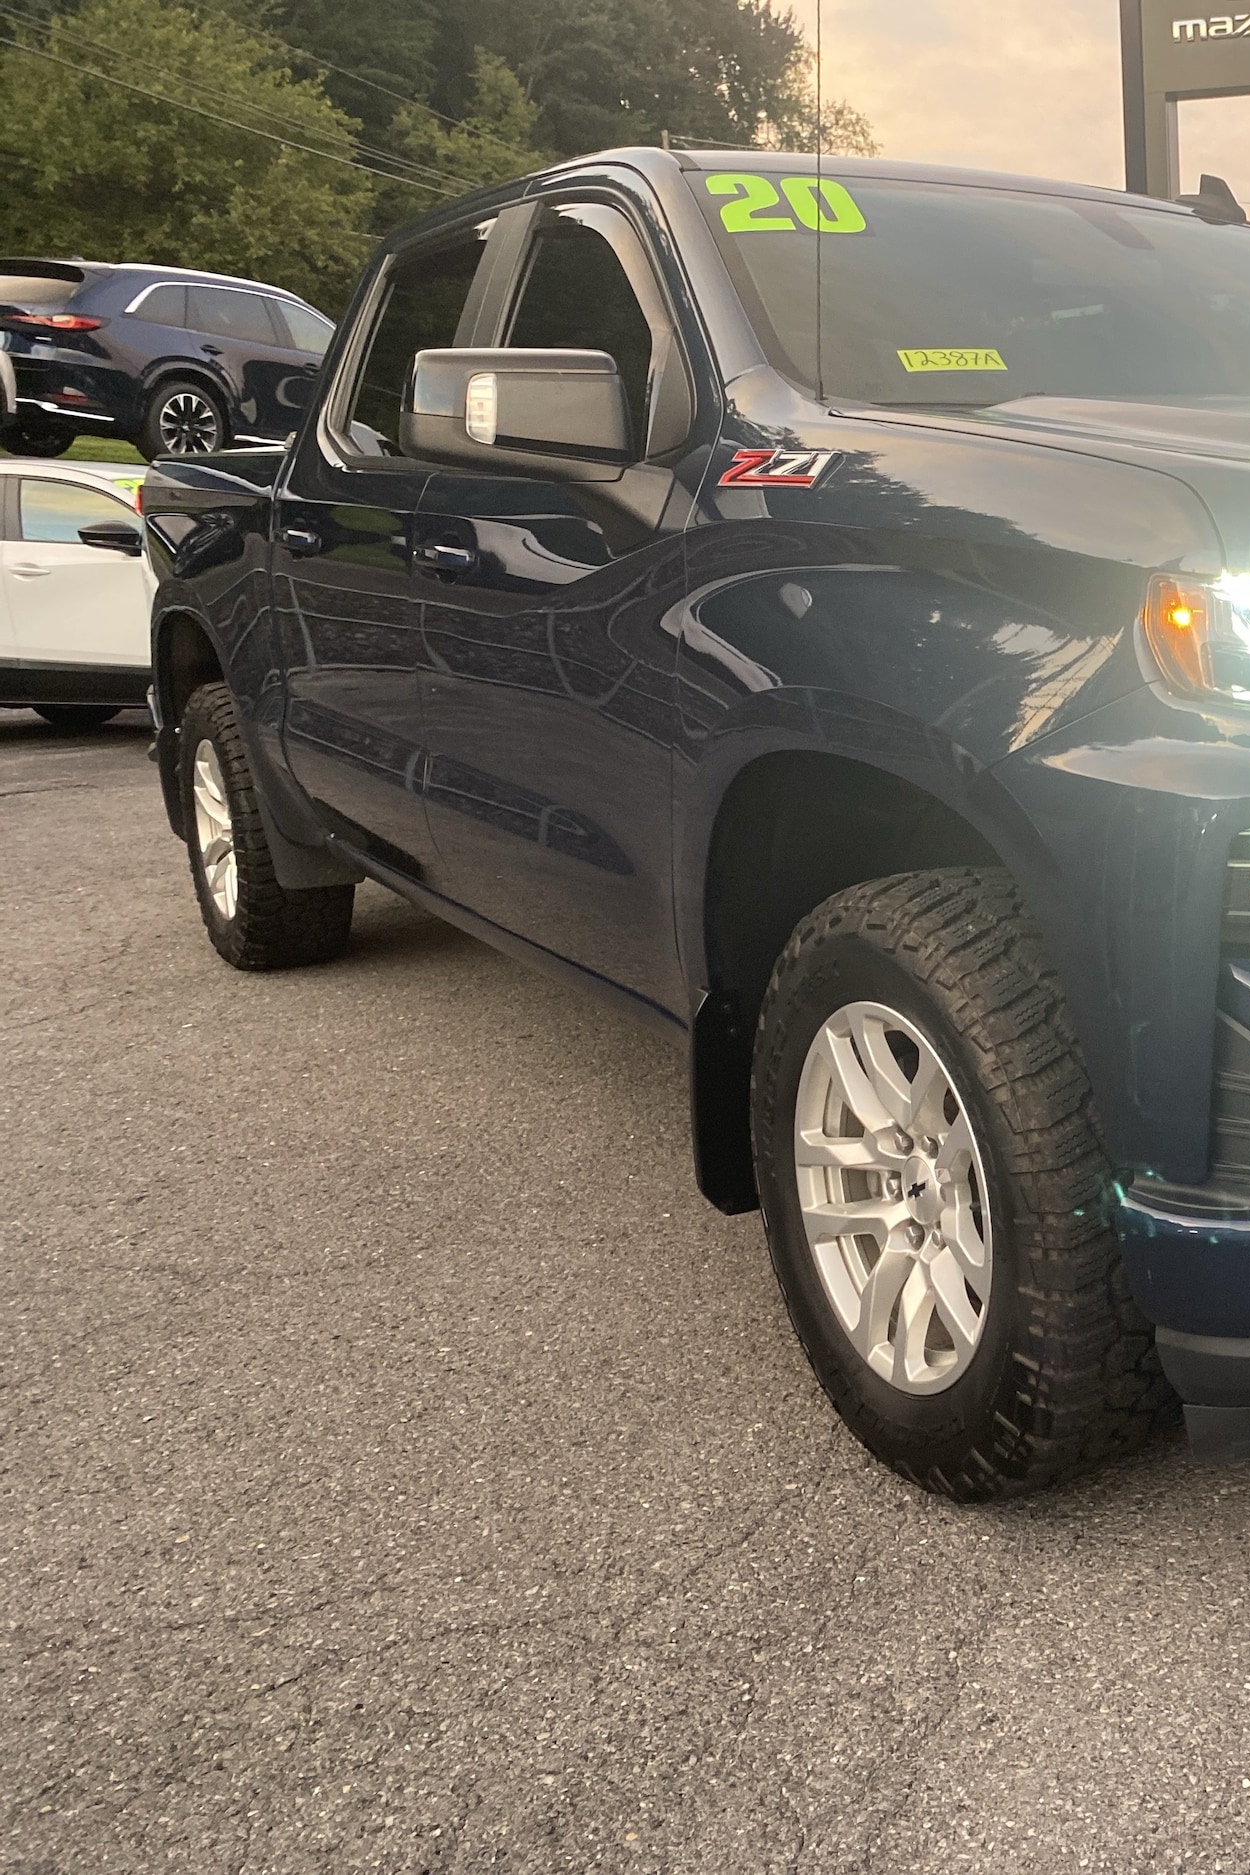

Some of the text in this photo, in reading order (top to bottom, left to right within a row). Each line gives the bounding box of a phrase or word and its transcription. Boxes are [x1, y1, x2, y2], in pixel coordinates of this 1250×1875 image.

[705, 173, 866, 233] 20
[903, 350, 1001, 368] 12387A
[717, 448, 843, 489] Z71
